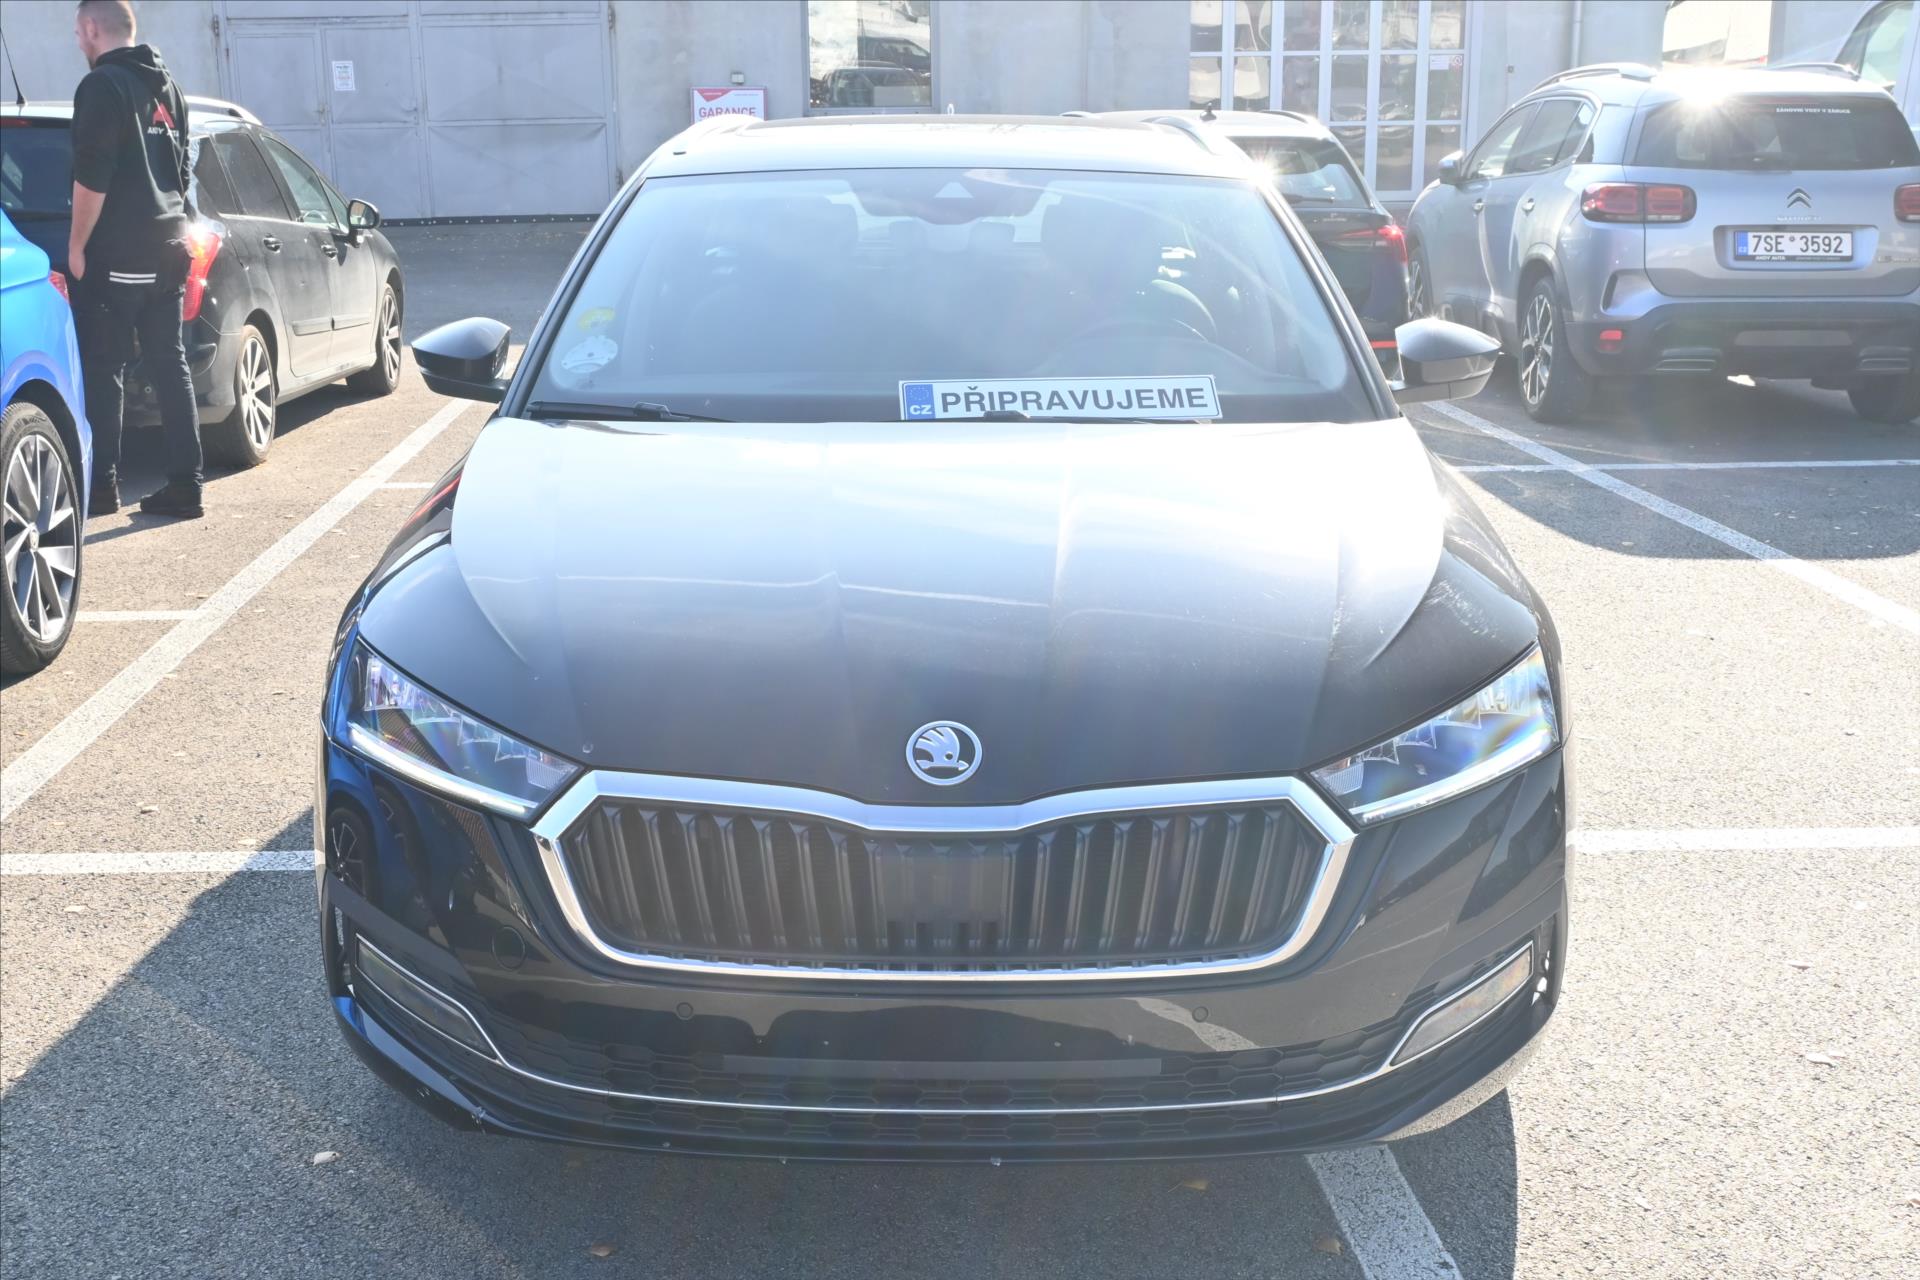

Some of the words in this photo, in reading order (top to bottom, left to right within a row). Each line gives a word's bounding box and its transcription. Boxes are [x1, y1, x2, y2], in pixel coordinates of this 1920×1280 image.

[1752, 235, 1785, 253] 7SE
[1800, 235, 1843, 254] 3592
[941, 386, 1208, 413] PŘIPRAVUJEME
[910, 404, 932, 416] CZ
